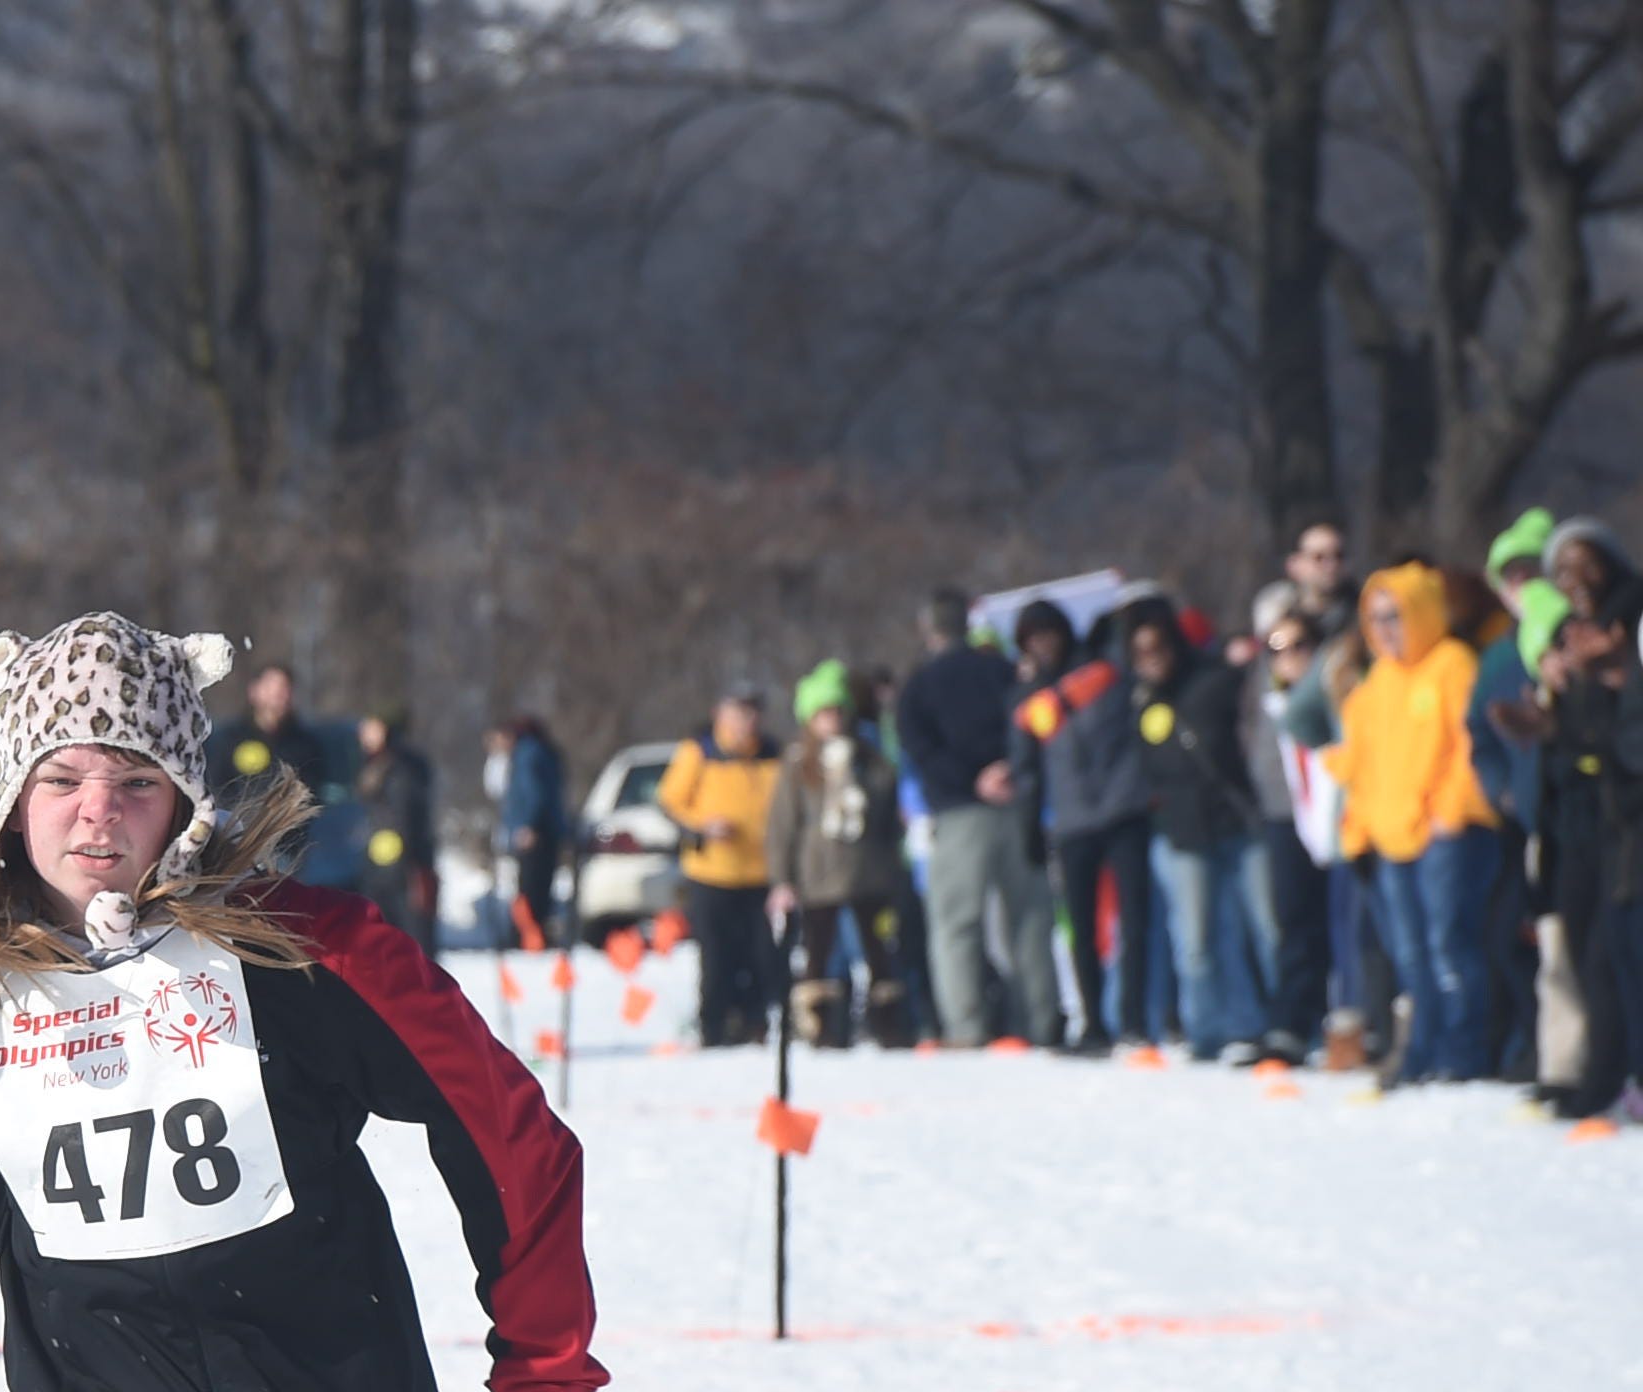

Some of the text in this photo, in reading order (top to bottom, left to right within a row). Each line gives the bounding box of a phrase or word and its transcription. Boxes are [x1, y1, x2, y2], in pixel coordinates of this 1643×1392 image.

[13, 995, 121, 1036] Special
[43, 1057, 129, 1090] New York
[42, 1097, 242, 1224] 478
